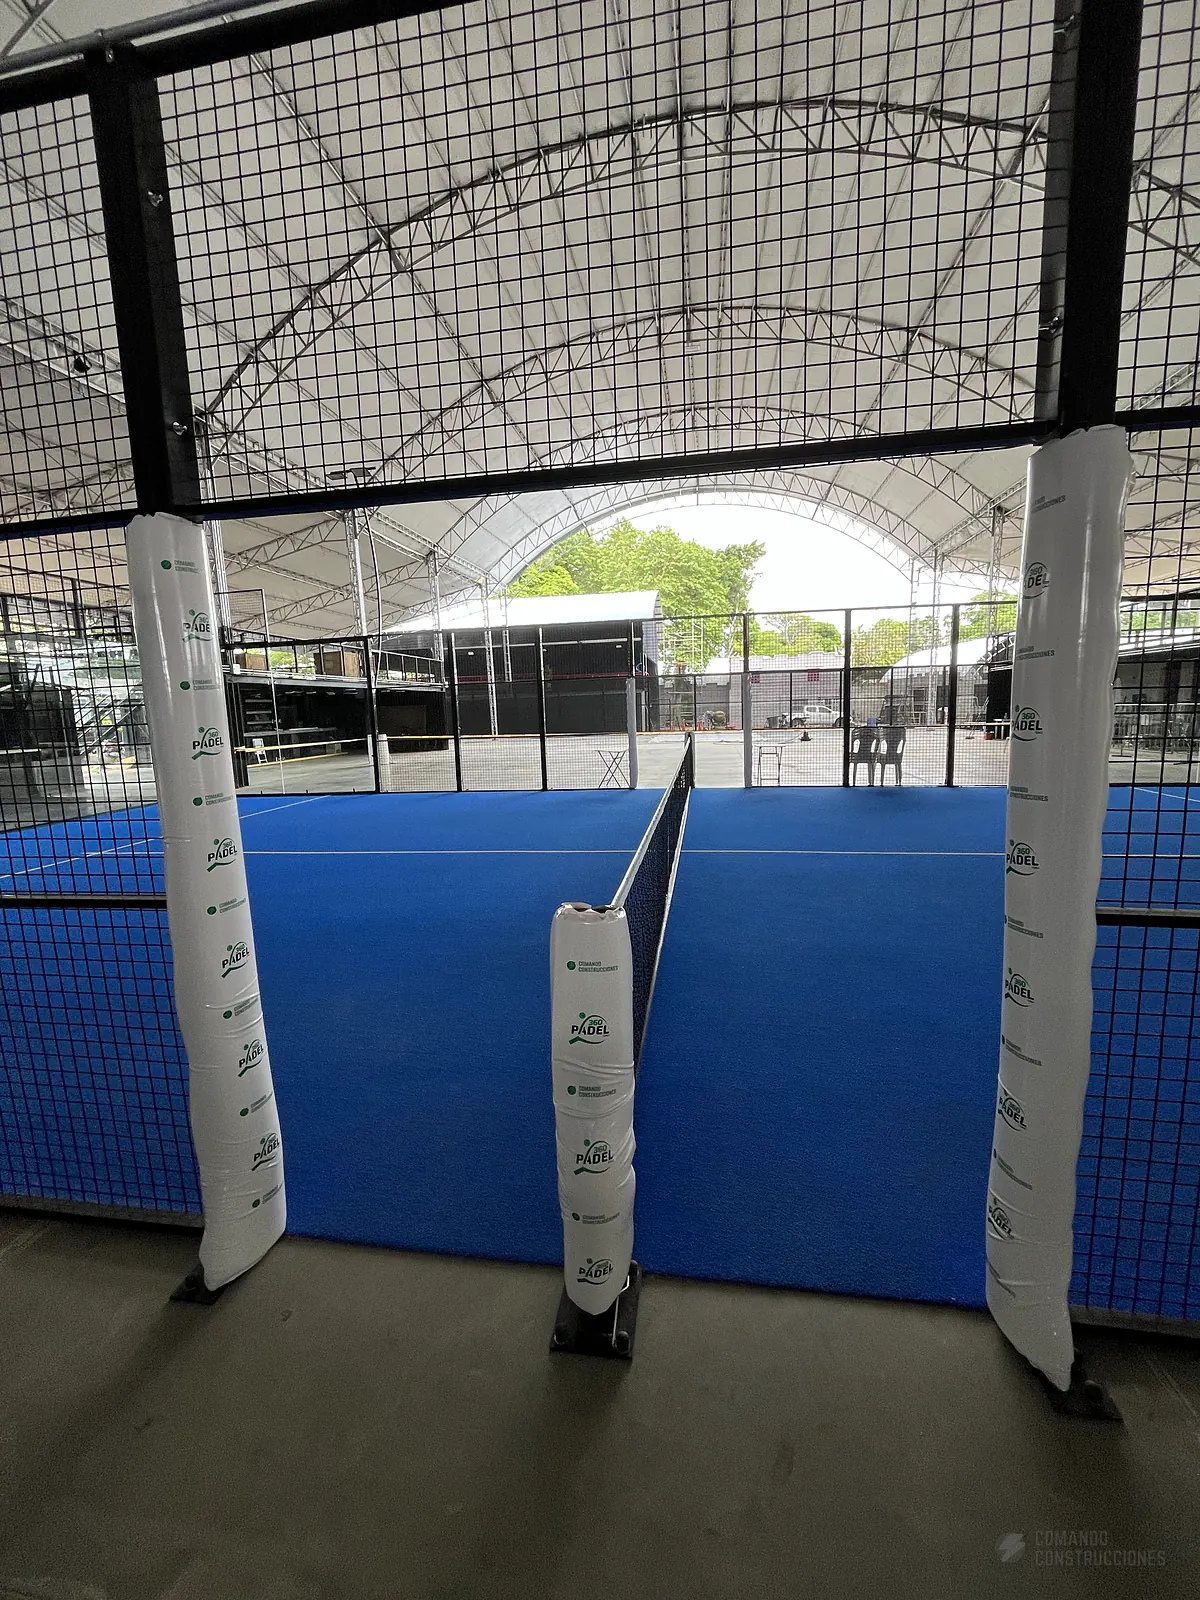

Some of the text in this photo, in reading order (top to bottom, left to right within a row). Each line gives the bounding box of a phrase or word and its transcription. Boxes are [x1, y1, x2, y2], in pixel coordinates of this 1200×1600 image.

[183, 622, 210, 633] PADE
[1021, 712, 1035, 720] 360
[208, 731, 218, 739] 360
[193, 737, 224, 750] PADEL
[207, 845, 237, 862] PADEL
[1006, 853, 1039, 866] PADEL
[222, 947, 249, 969] PADEL
[571, 1025, 610, 1035] PADEL
[239, 1044, 264, 1068] PADEL
[254, 1138, 280, 1162] PADEL
[594, 1145, 607, 1153] 360
[576, 1150, 614, 1164] PADEL
[578, 1263, 613, 1278] PADEL
